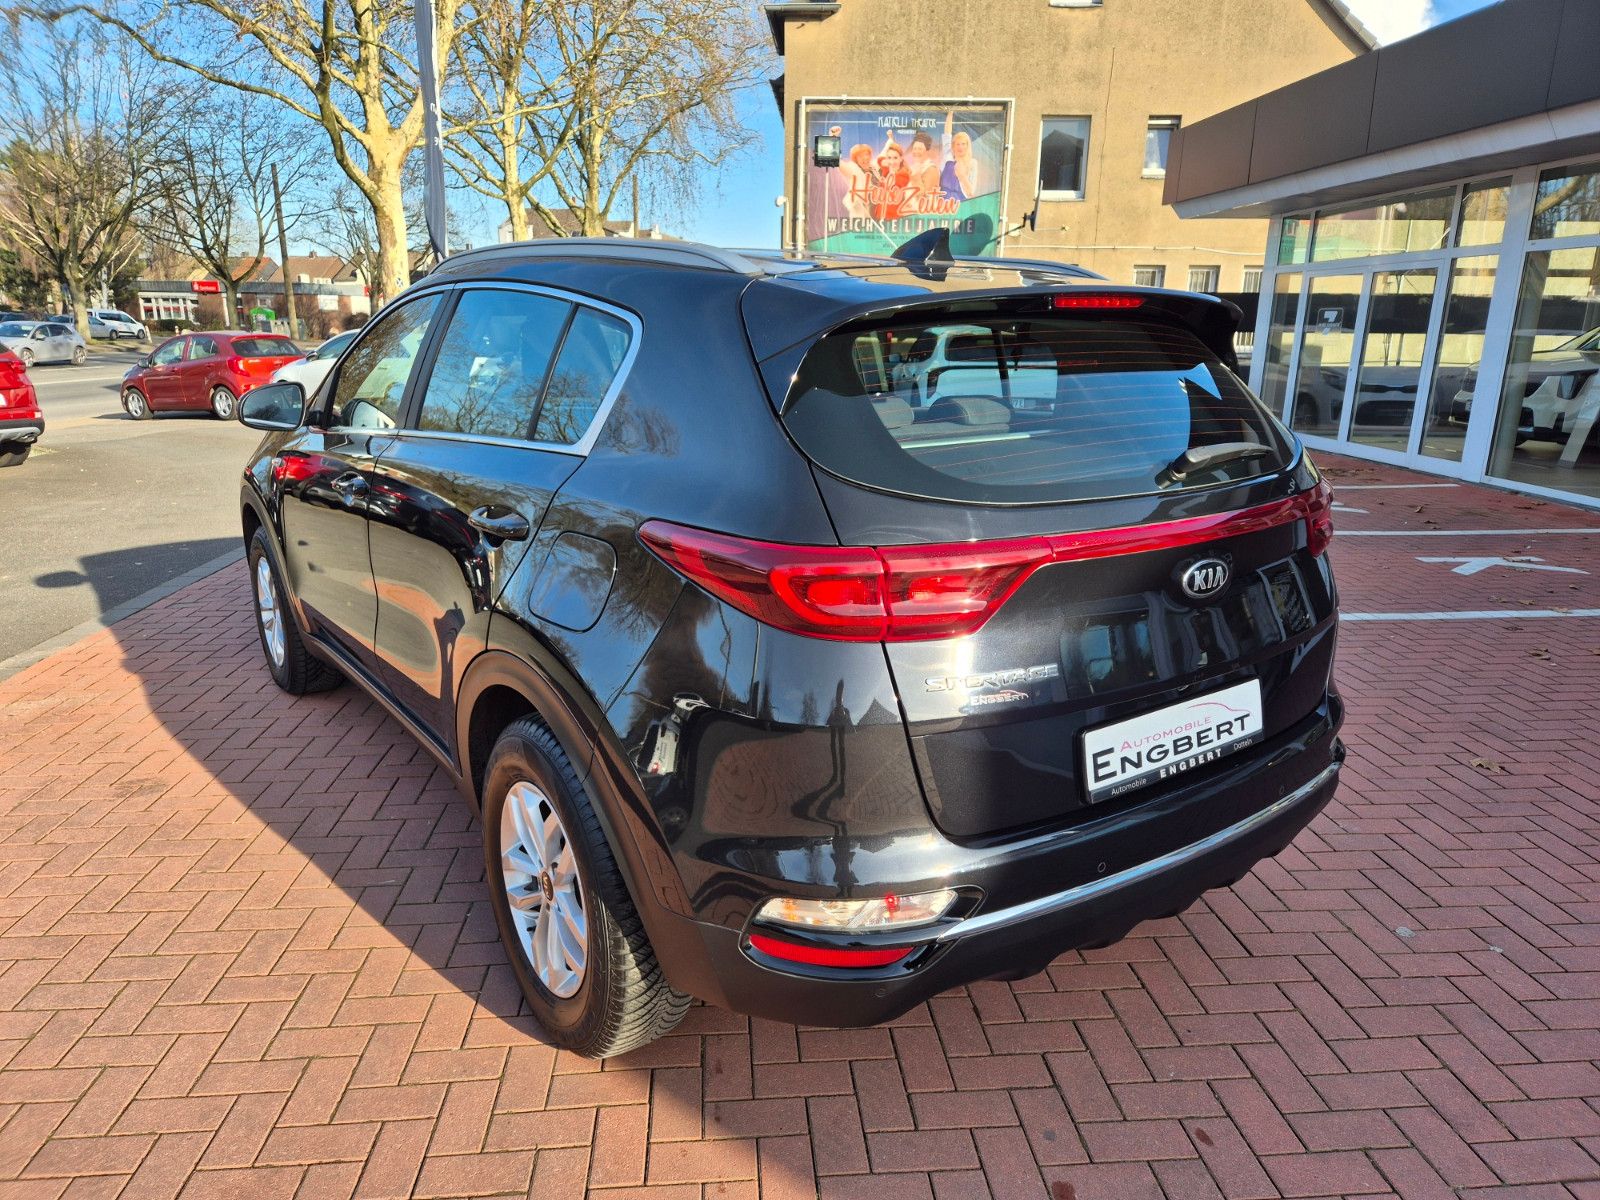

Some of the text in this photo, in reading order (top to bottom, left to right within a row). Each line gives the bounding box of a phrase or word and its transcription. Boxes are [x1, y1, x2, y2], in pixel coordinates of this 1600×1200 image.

[1193, 566, 1224, 591] KIA
[1111, 737, 1253, 796] Automobile ENGBERT Datteln
